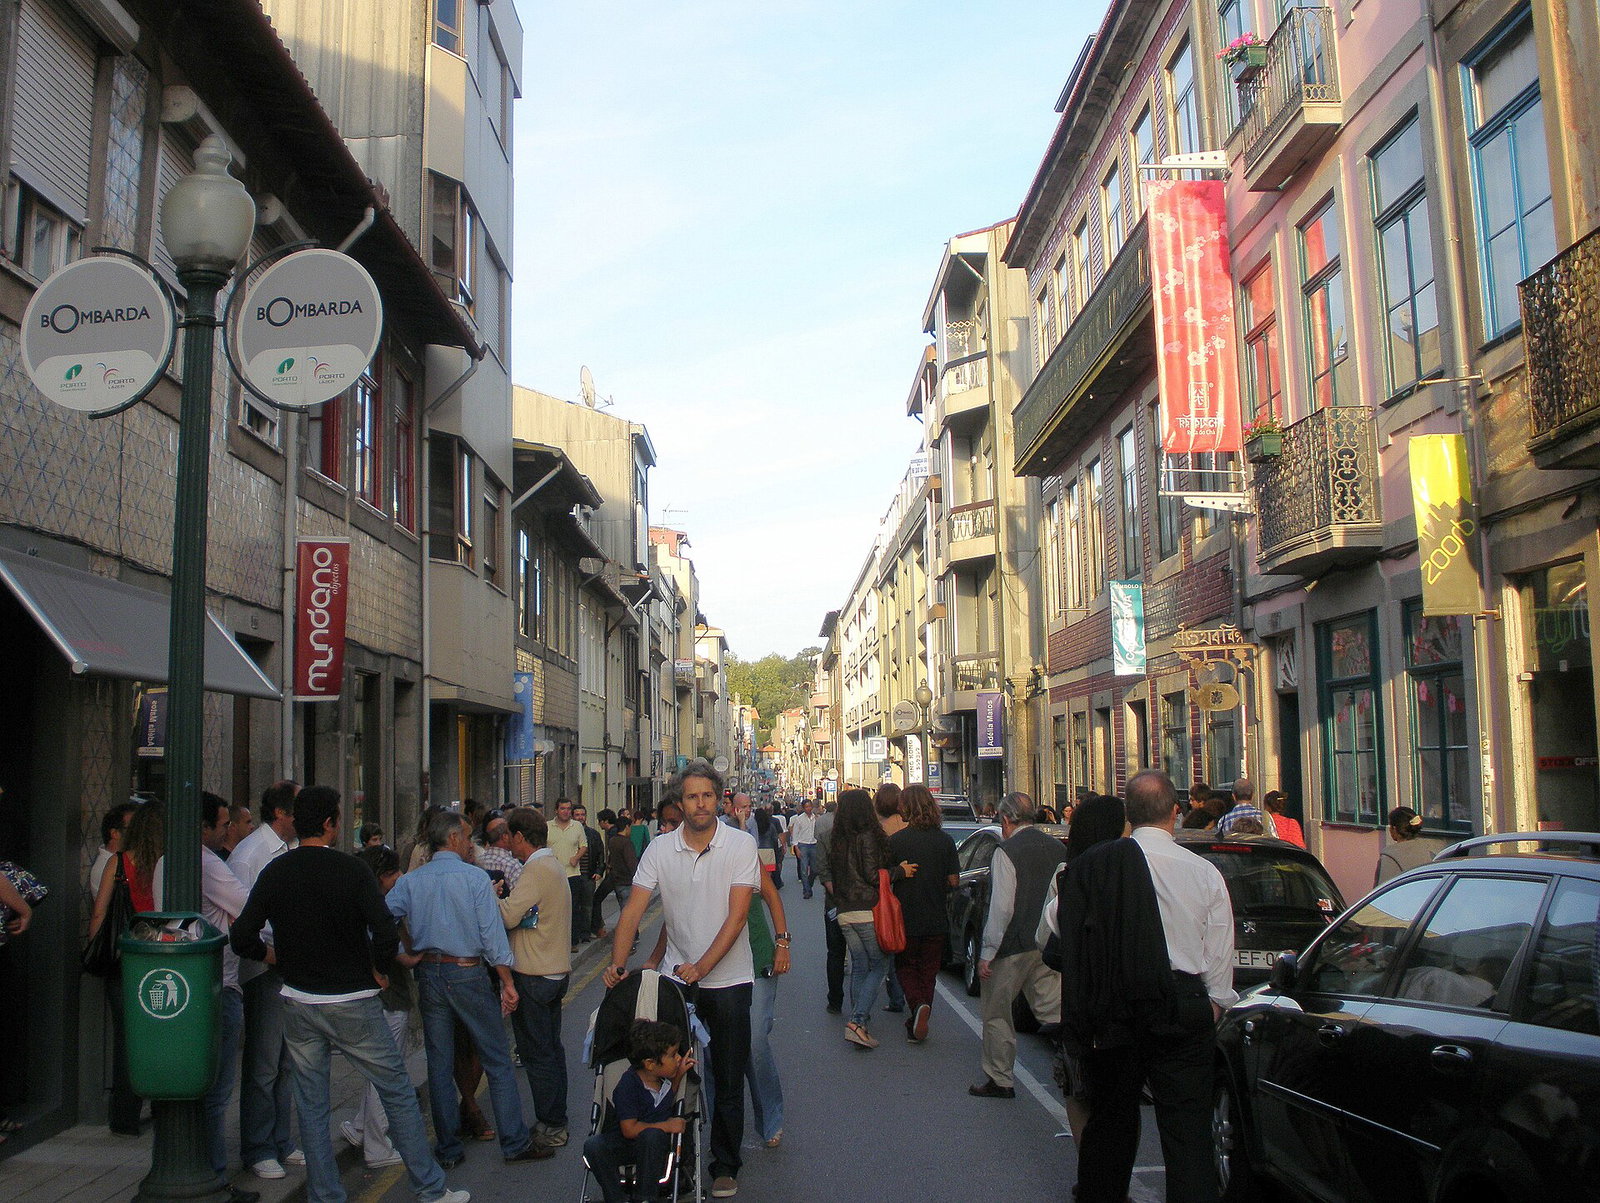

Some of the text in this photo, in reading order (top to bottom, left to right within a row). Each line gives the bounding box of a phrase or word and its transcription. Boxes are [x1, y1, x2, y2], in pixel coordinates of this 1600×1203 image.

[41, 304, 151, 334] BOMBARDA
[257, 296, 363, 327] BOMBARDA
[331, 563, 343, 595] objectos
[306, 547, 334, 692] mundano
[873, 741, 882, 753] P
[929, 764, 937, 776] P
